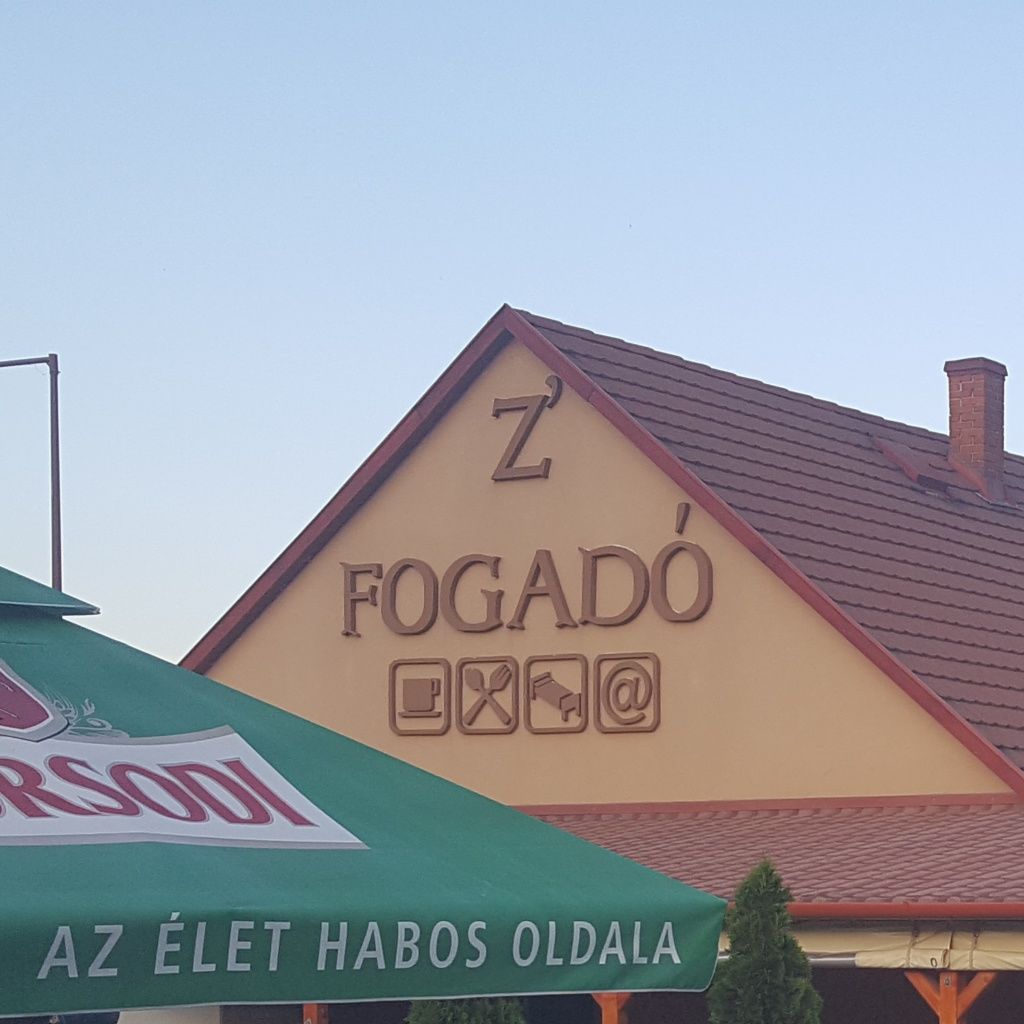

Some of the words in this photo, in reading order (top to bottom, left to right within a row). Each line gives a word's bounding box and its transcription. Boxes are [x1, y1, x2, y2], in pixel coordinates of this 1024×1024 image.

[339, 502, 714, 638] FOGADÓ
[0, 755, 320, 827] RSODI
[36, 925, 124, 980] AZ
[154, 911, 291, 975] ÉLET
[316, 920, 487, 970] HABOS
[512, 920, 682, 967] OLDALA
